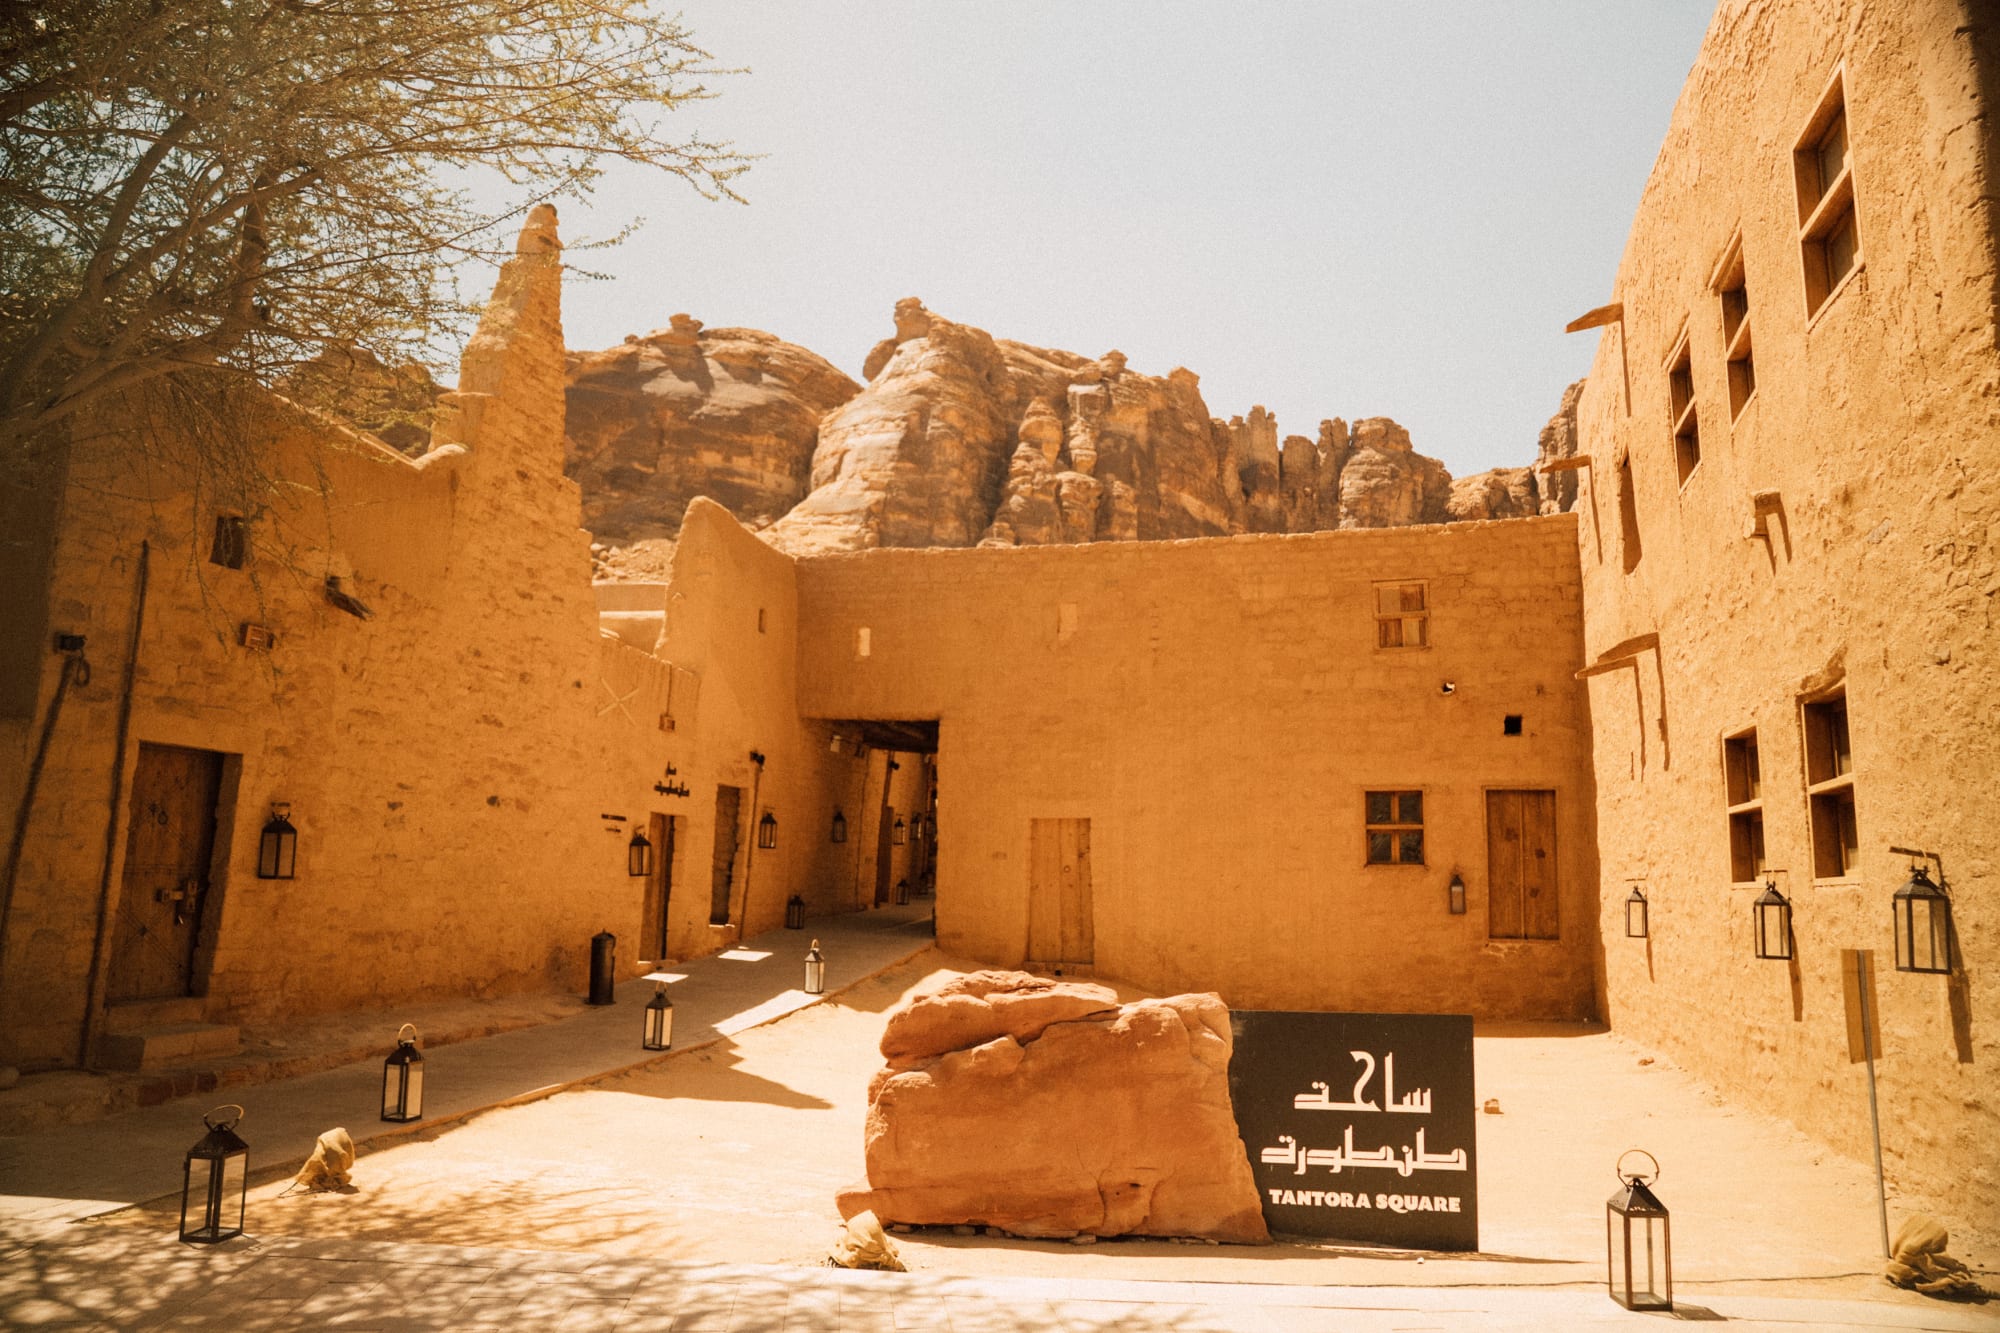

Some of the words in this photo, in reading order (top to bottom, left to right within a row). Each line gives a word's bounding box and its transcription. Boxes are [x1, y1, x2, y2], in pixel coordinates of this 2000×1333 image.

[1294, 1050, 1432, 1114] ساحة
[1261, 1124, 1467, 1177] طنطورة
[1268, 1189, 1372, 1209] TANTORA
[1375, 1193, 1461, 1214] SQUARE
